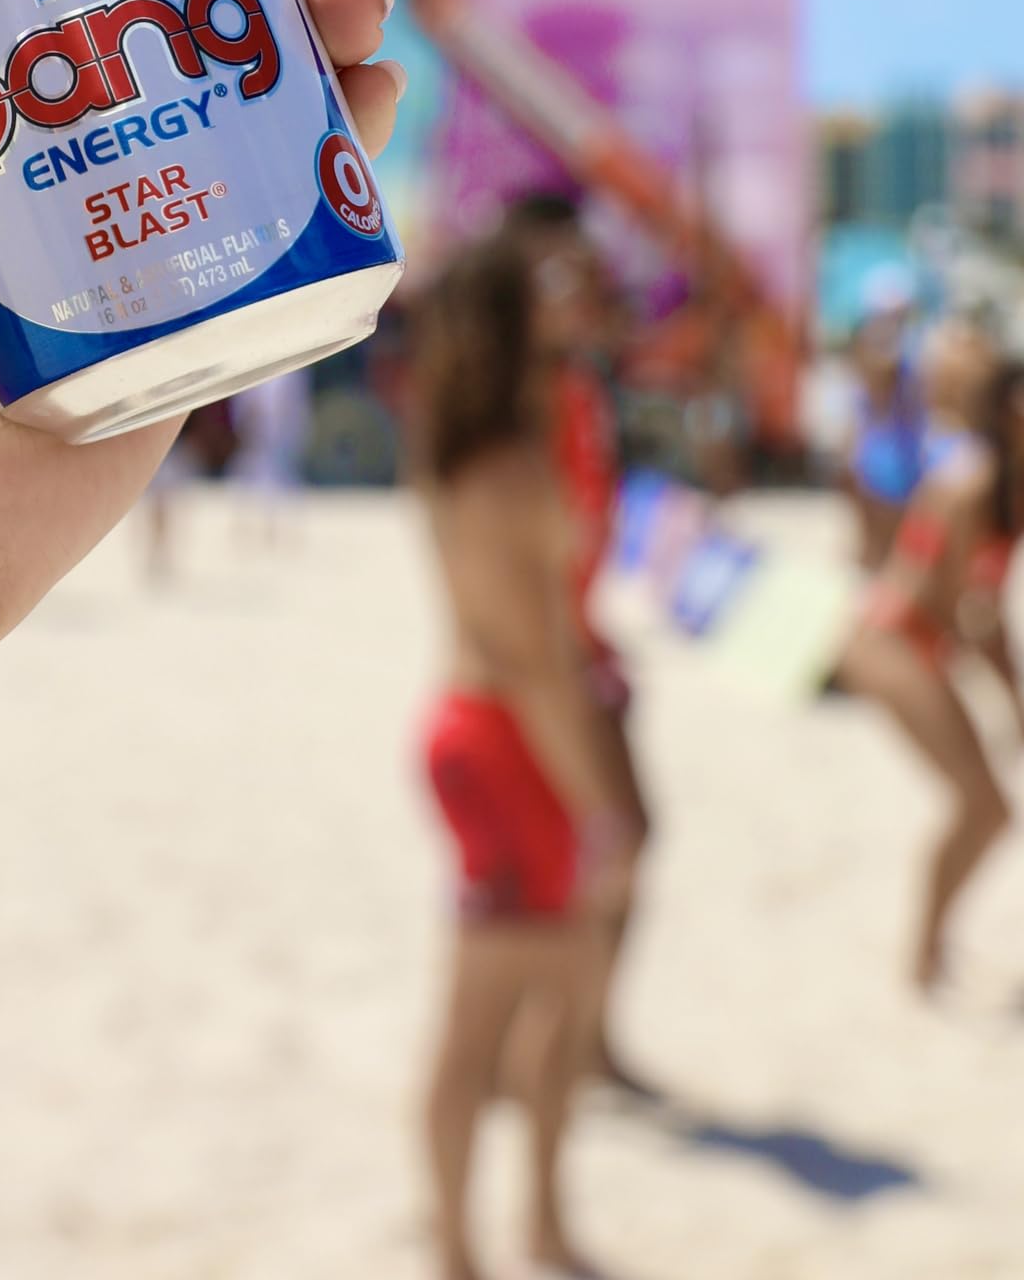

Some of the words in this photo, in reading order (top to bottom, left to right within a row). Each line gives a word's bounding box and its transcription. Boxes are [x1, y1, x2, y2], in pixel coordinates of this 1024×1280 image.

[83, 163, 191, 225] STAR
[333, 150, 370, 208] 0
[119, 276, 134, 294] &
[136, 242, 223, 290] FICIAL
[221, 218, 291, 257] FLAVS
[198, 264, 227, 288] 473
[228, 256, 255, 278] mL
